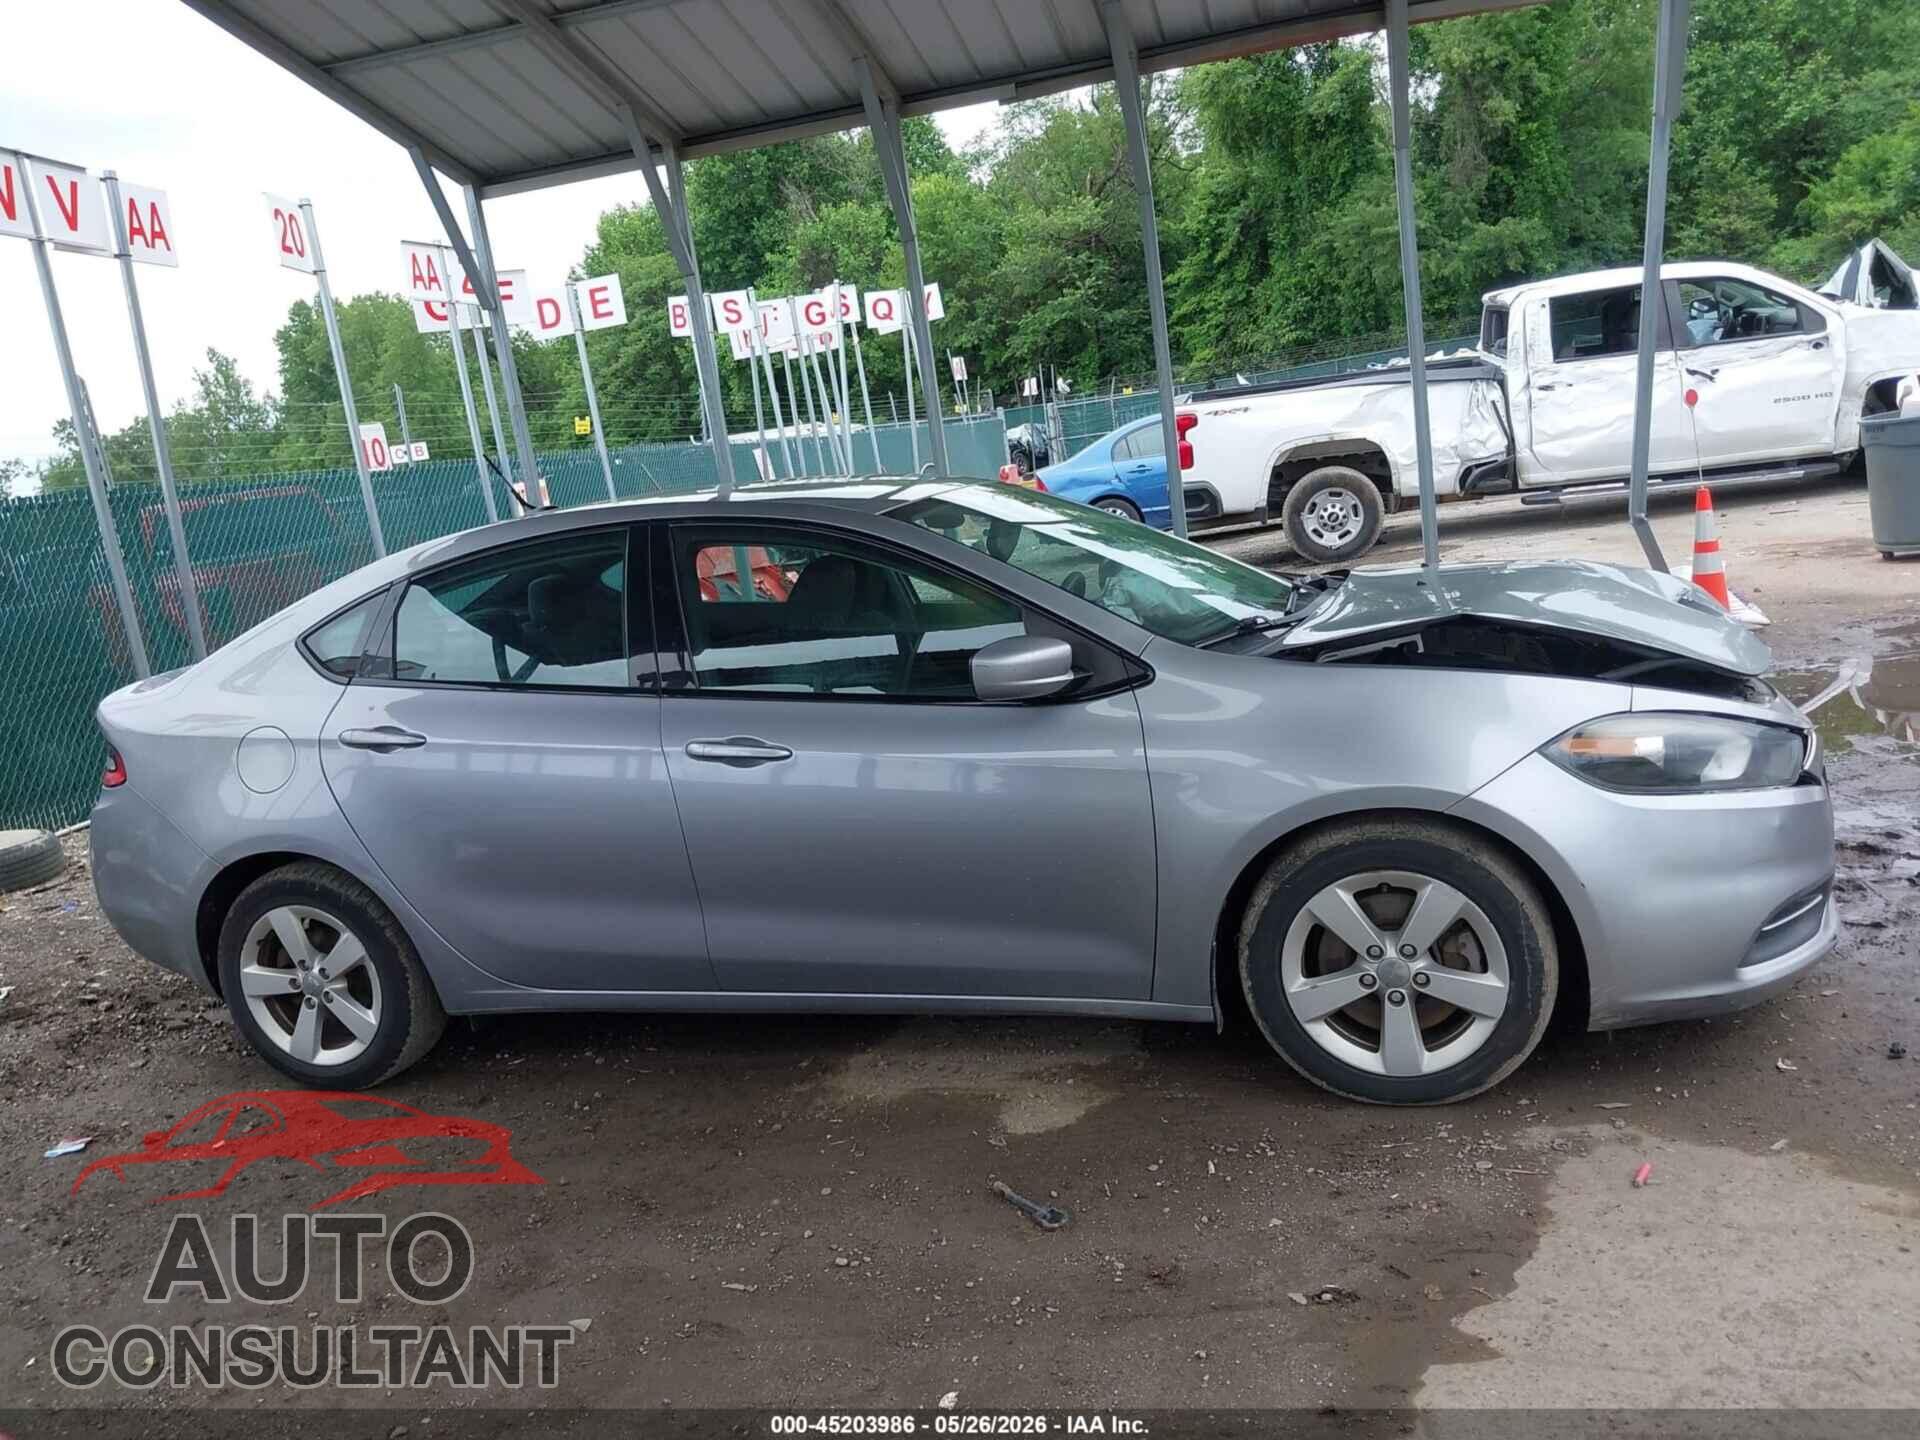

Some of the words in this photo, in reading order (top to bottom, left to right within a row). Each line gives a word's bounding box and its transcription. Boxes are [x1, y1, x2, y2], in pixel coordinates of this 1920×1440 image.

[46, 175, 78, 232] V
[128, 197, 171, 252] AA
[274, 207, 305, 258] 20
[411, 252, 443, 292] AA
[536, 298, 562, 330] D
[588, 285, 614, 320] E
[672, 303, 687, 329] B
[722, 299, 743, 324] S
[804, 301, 827, 326] G
[872, 297, 894, 321] Q
[414, 445, 425, 457] B
